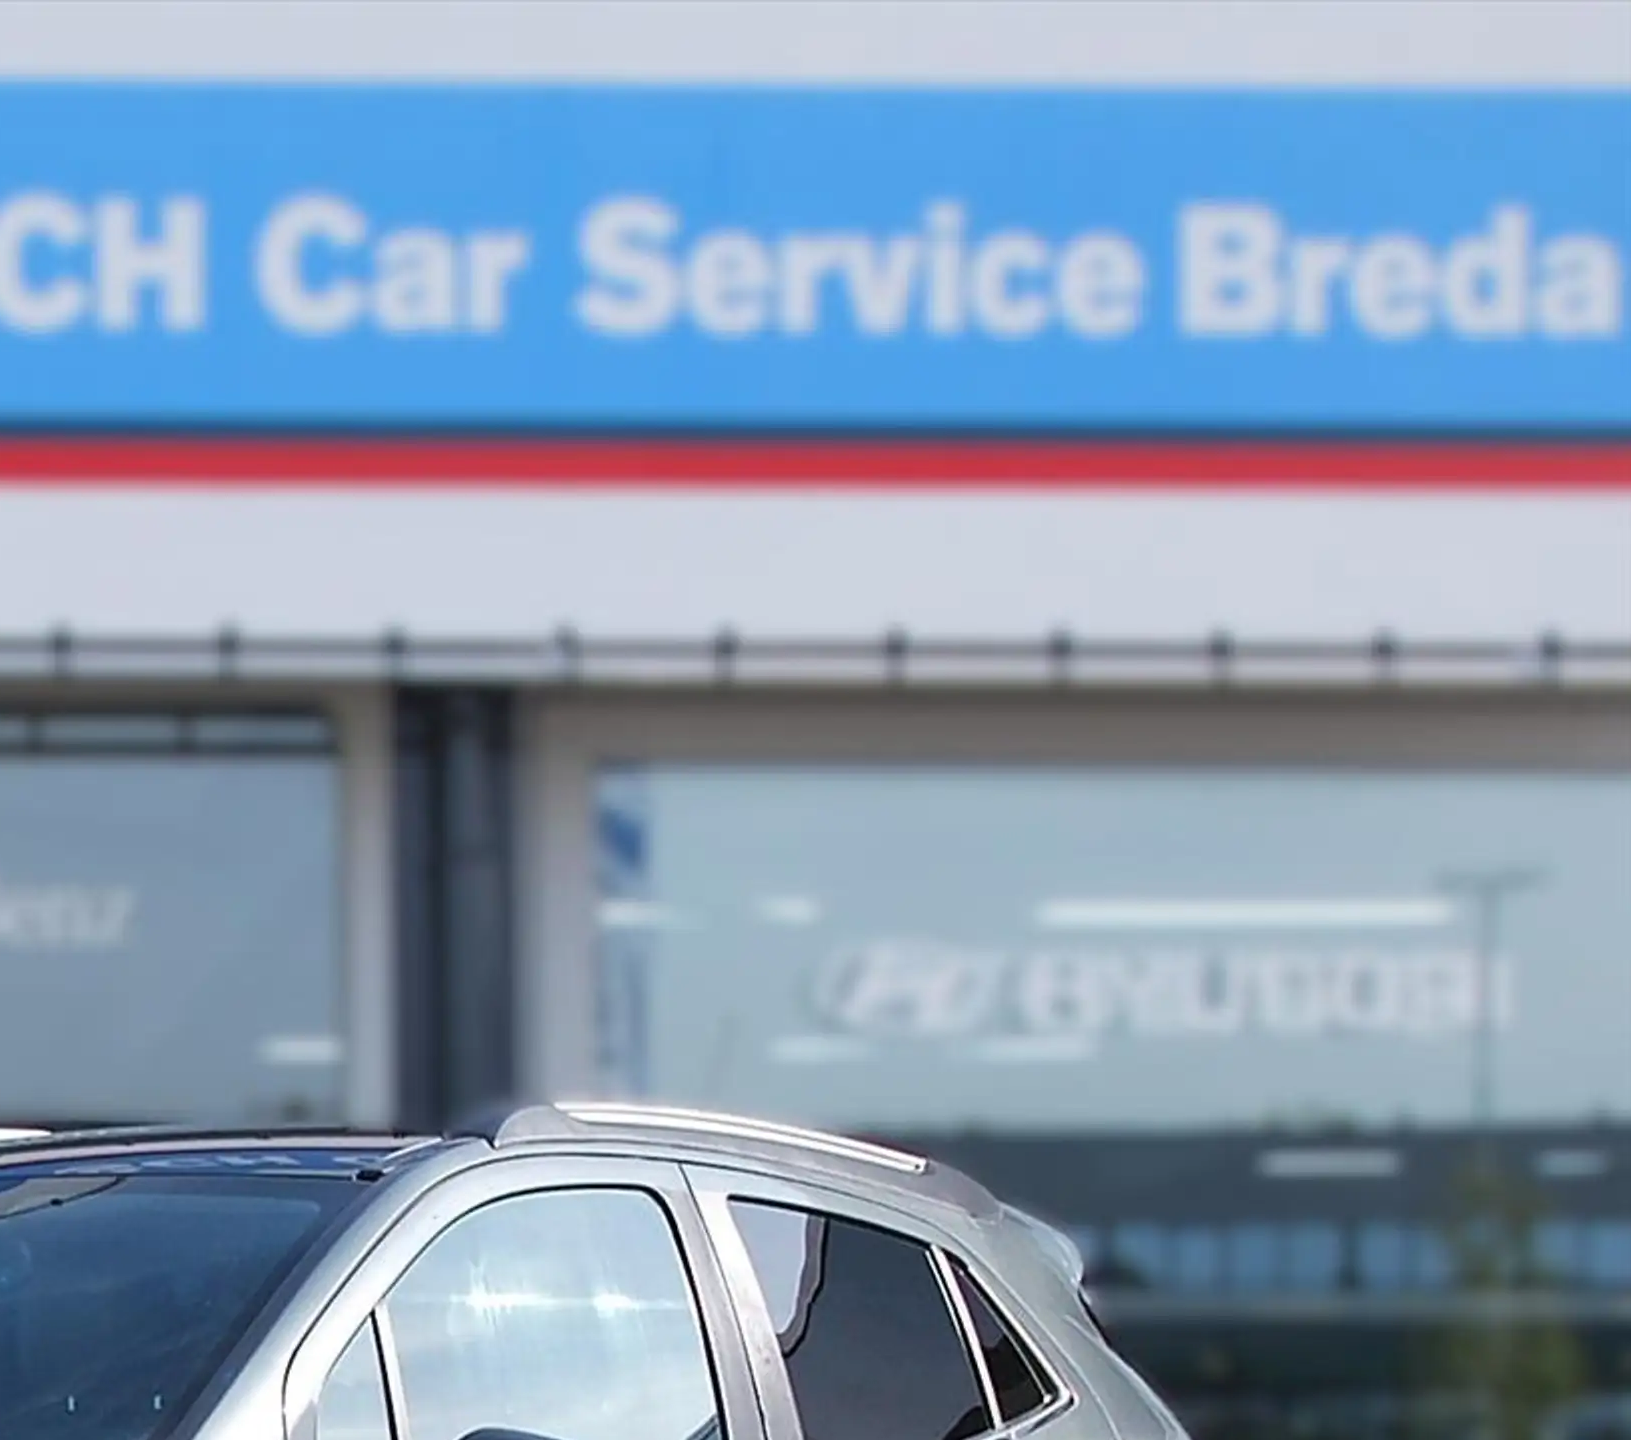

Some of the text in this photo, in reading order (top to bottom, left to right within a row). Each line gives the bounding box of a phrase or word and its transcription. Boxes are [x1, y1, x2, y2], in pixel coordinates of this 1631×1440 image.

[256, 194, 523, 334] Car
[575, 200, 1141, 335] Service
[1180, 203, 1621, 338] Breda
